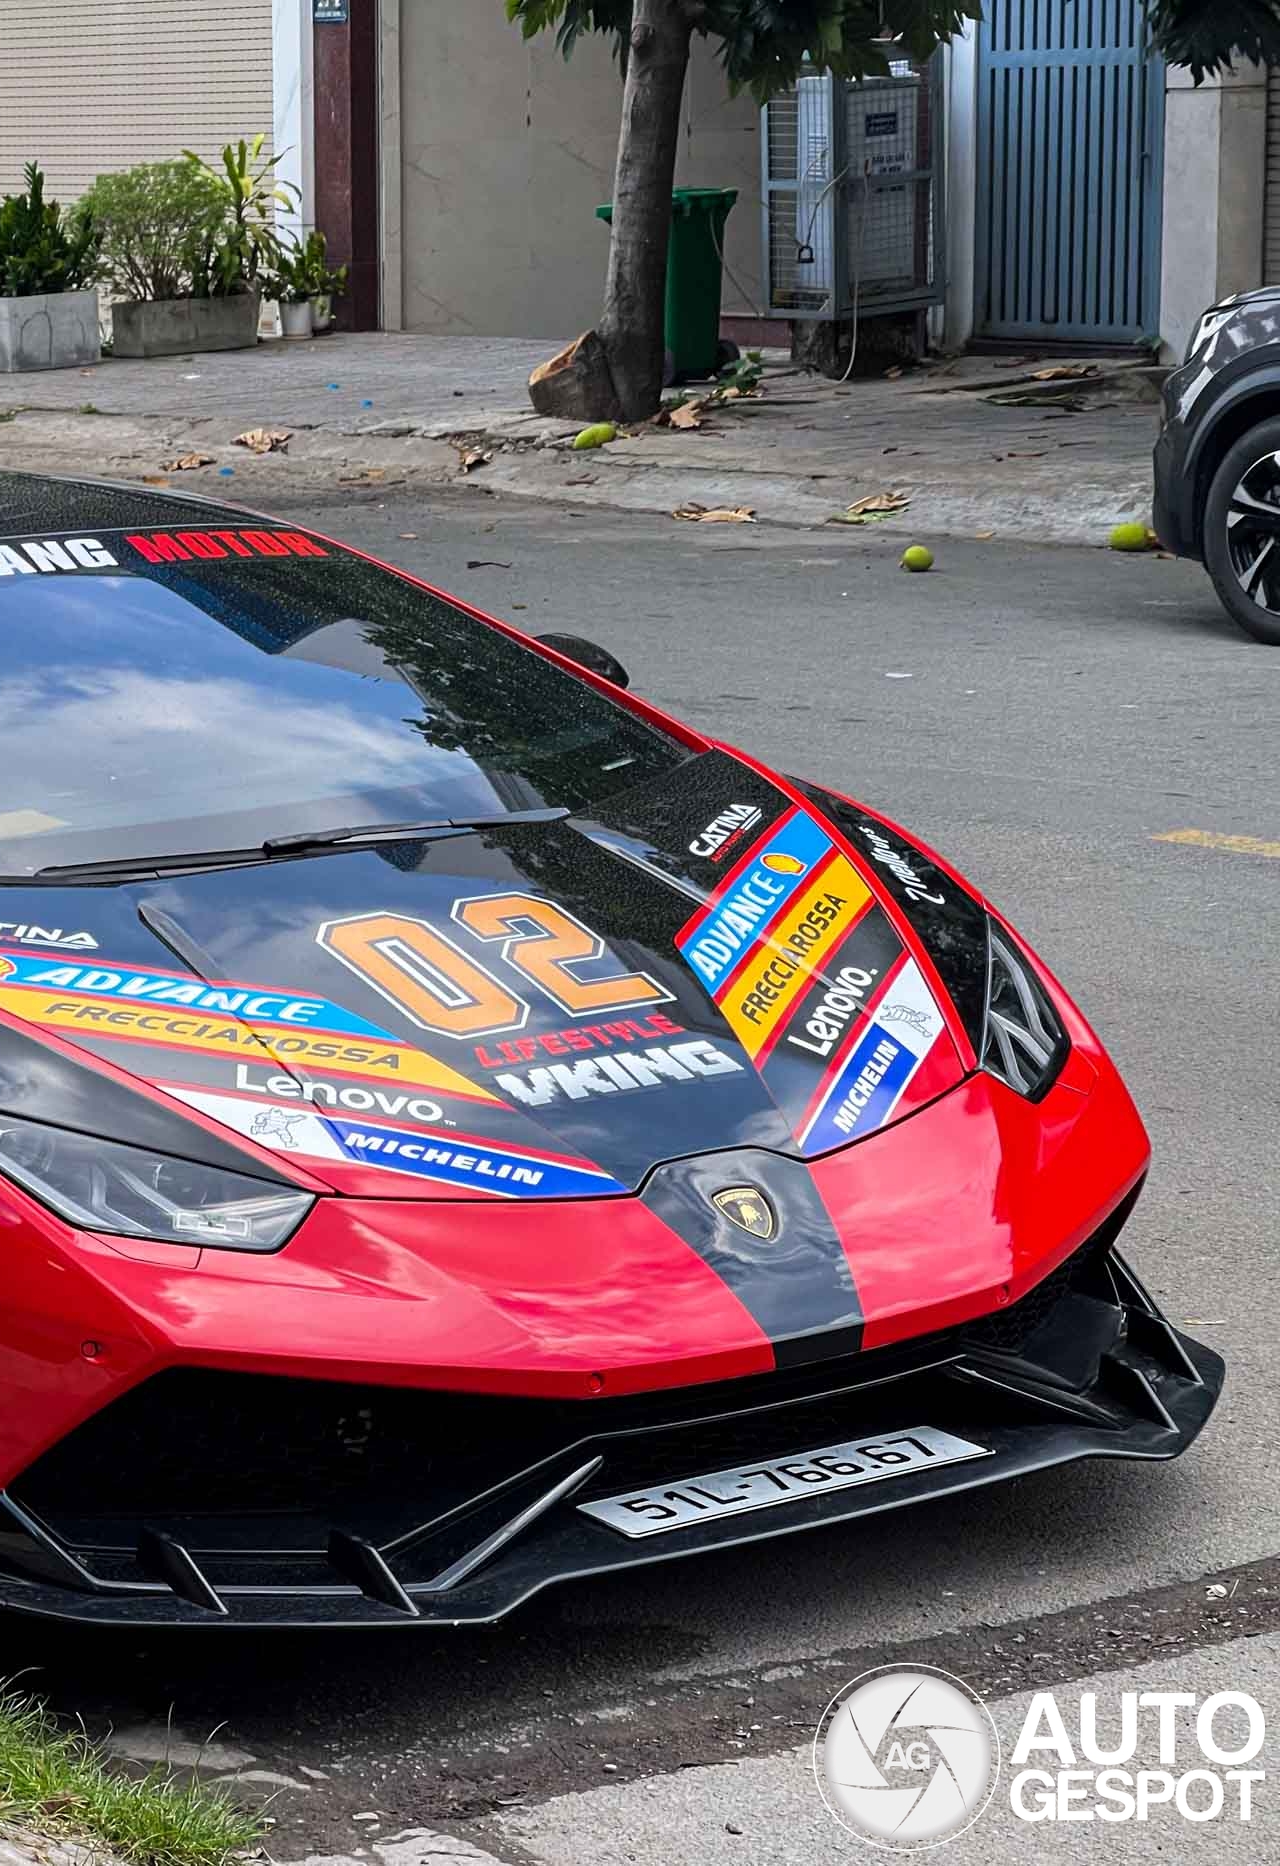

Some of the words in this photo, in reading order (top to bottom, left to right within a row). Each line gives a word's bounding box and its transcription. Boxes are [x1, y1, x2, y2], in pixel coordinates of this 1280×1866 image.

[126, 531, 328, 563] MOTOR
[689, 804, 757, 856] CATINA
[870, 846, 927, 890] riello
[689, 871, 784, 982] ADVANCE
[316, 892, 678, 1039] 02
[740, 893, 848, 1025] FRECCIAROSSA
[23, 966, 324, 1022] ADVANCE
[44, 1002, 400, 1069] FRECCIAROSSA
[474, 1014, 686, 1068] LIFESTYLE
[832, 1040, 900, 1134] MICHELIN
[343, 1133, 544, 1186] MICHELIN
[622, 1437, 934, 1521] 51L-766.67
